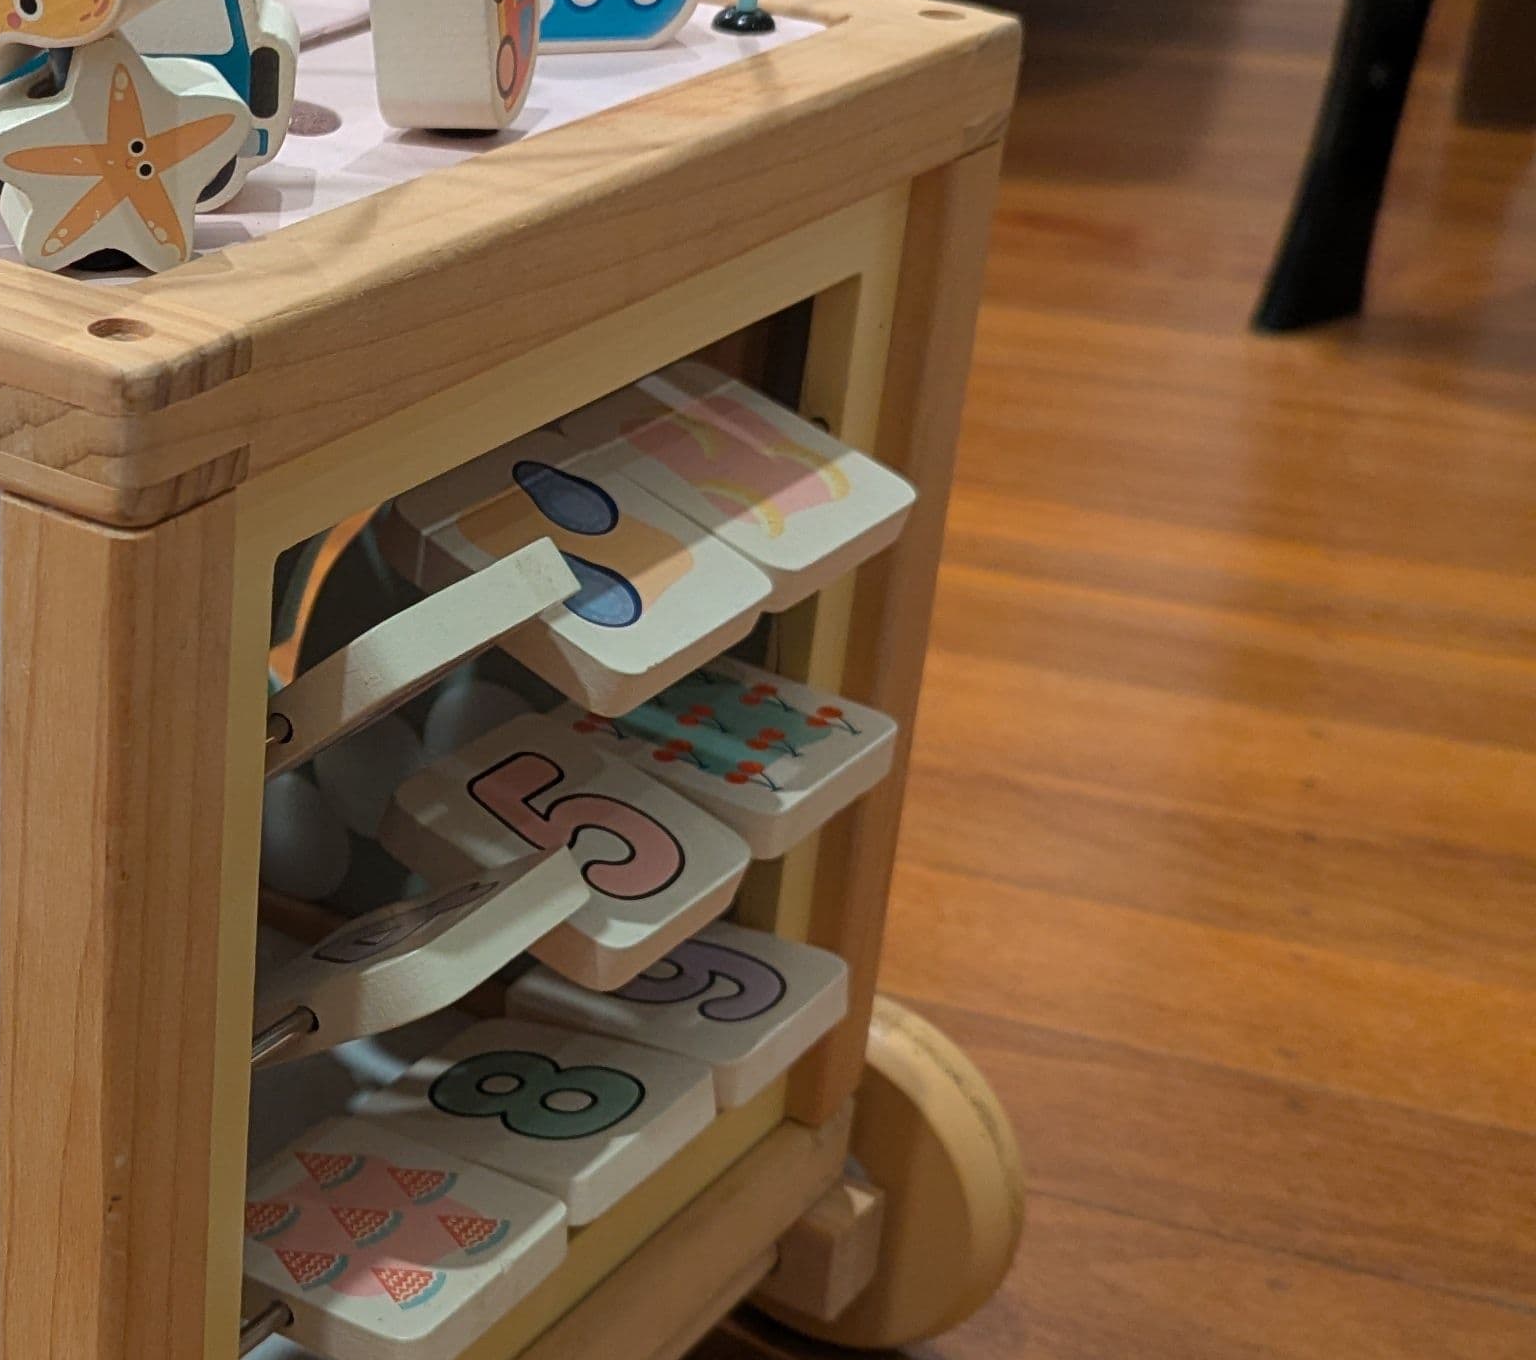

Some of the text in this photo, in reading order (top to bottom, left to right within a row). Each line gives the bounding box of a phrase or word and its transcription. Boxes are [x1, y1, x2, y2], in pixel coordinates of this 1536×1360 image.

[467, 752, 686, 901] 5
[603, 938, 787, 1022] 9
[427, 1050, 646, 1140] 8
